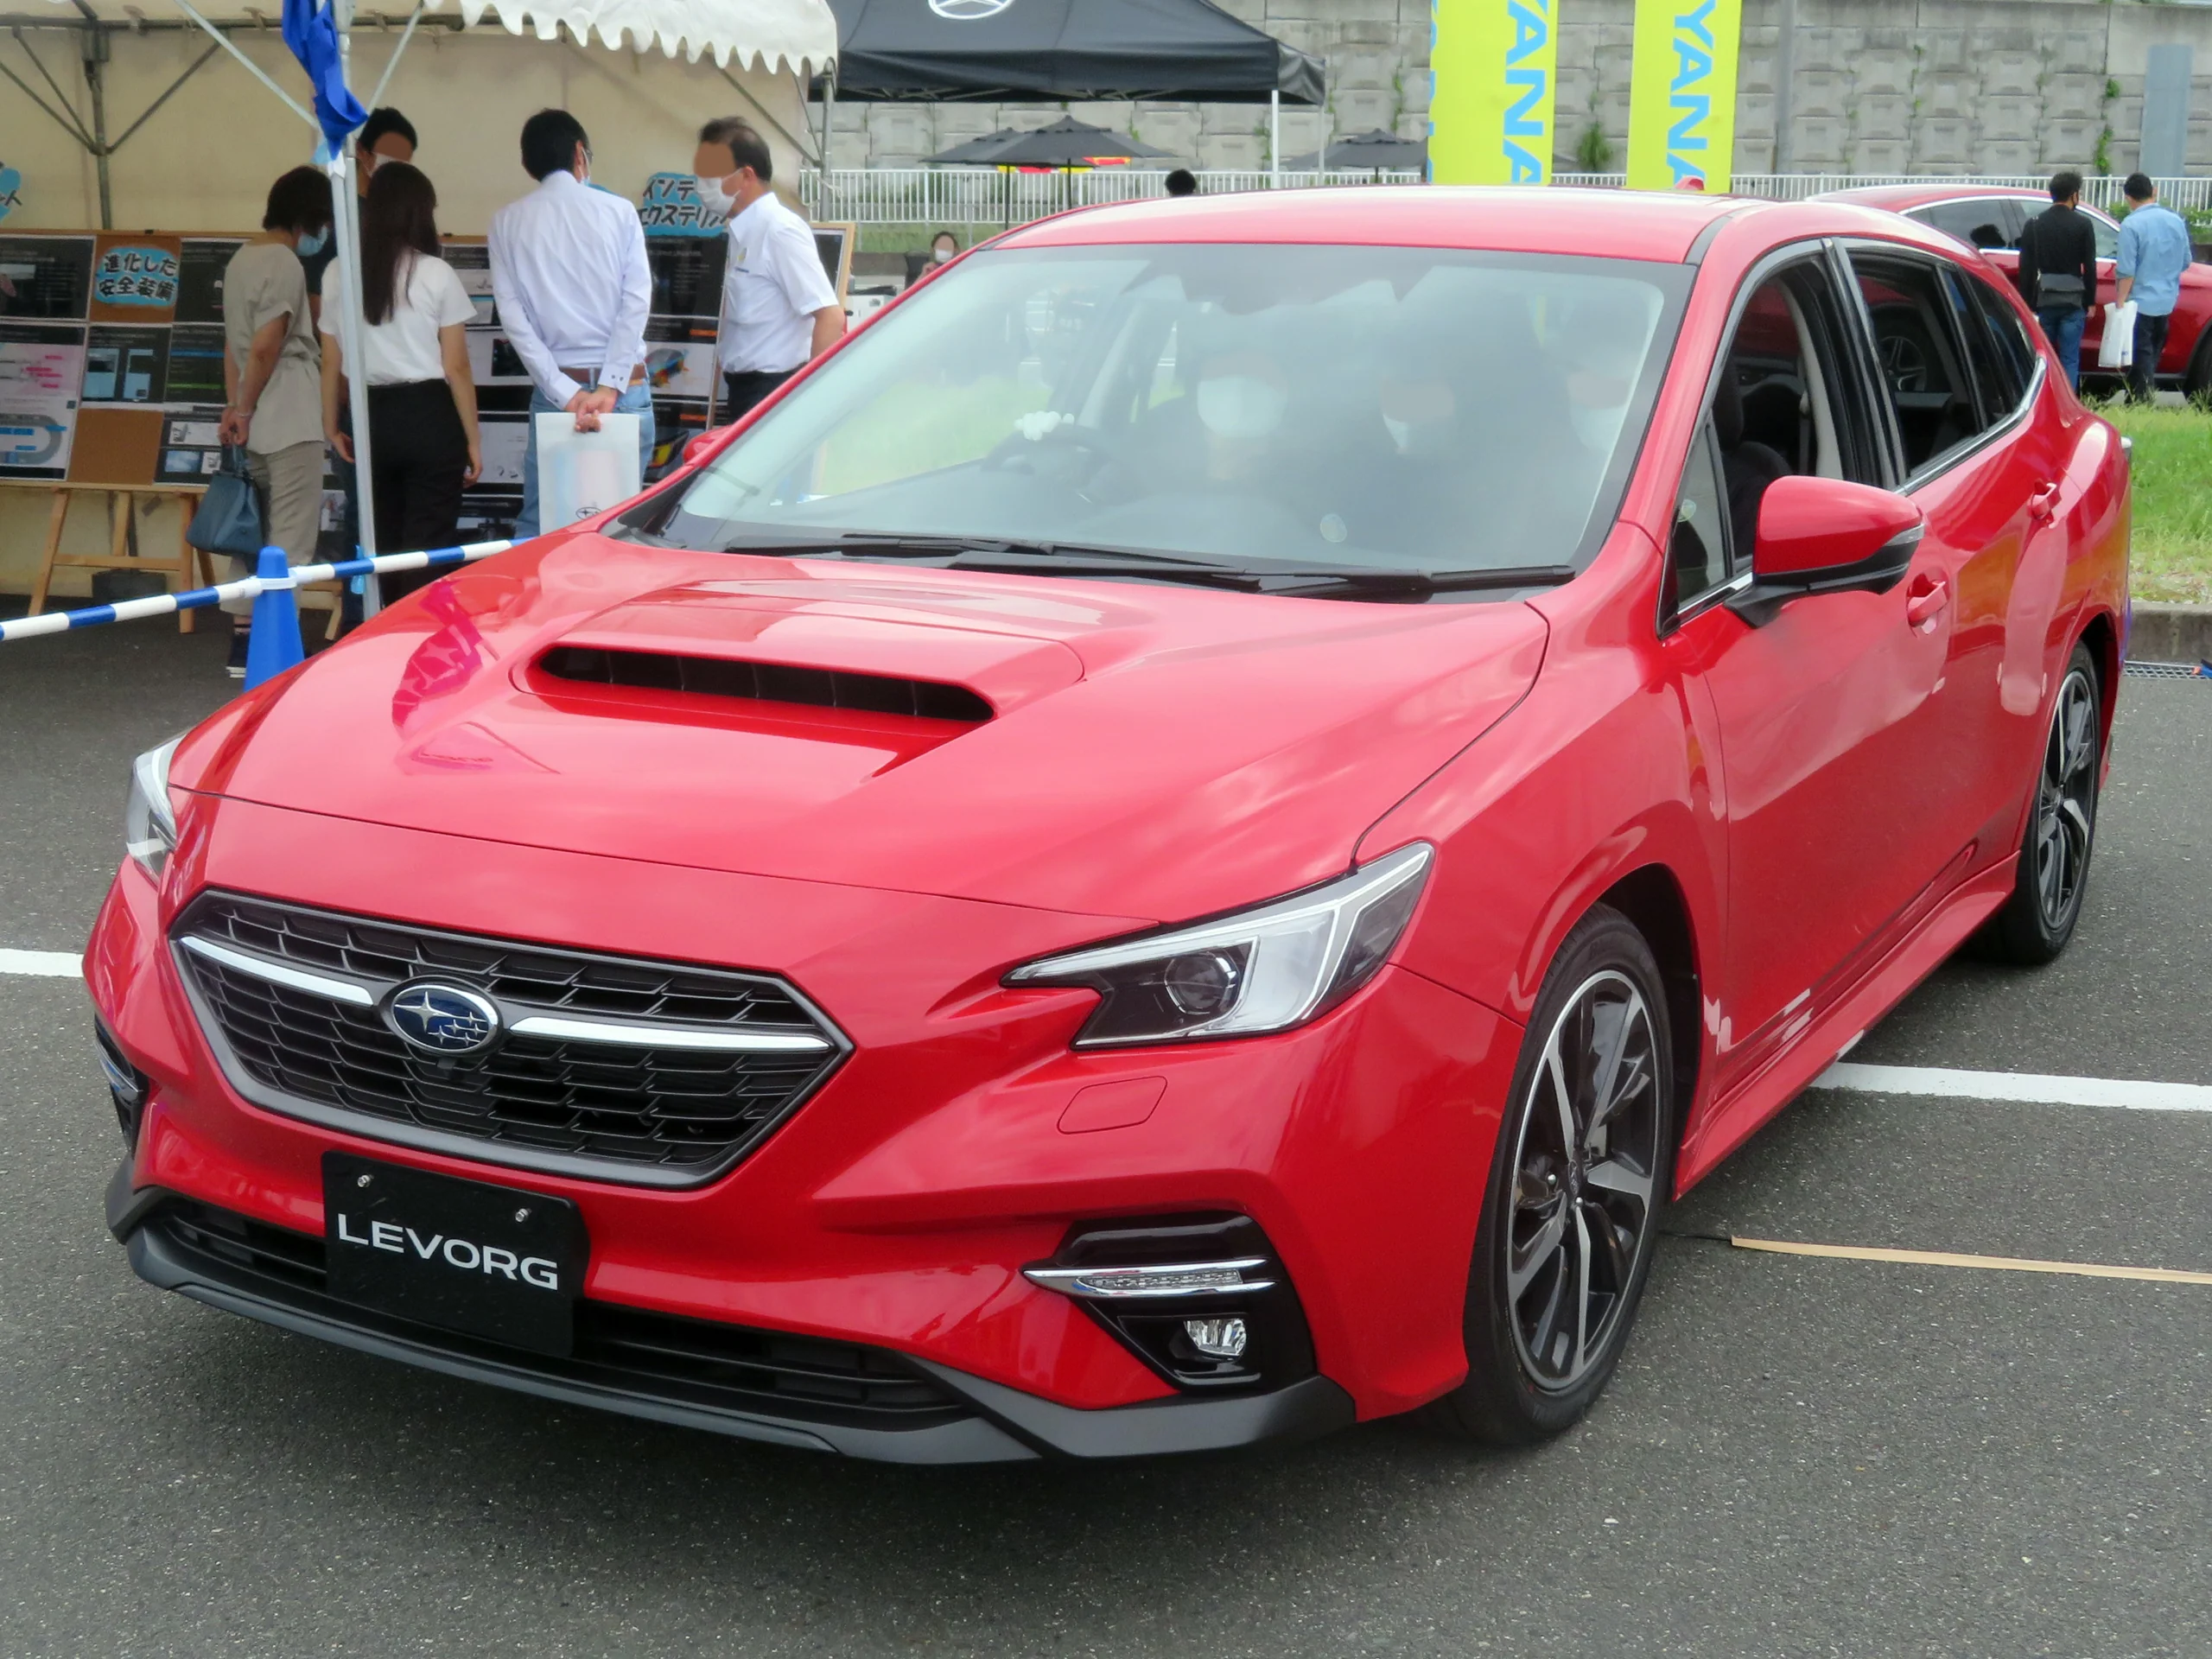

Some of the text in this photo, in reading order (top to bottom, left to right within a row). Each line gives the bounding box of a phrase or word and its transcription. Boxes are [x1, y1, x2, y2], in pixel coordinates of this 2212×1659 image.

[1502, 0, 1548, 184] ANA
[99, 276, 175, 302] 安全装備
[105, 252, 176, 276] 進化した
[338, 1213, 558, 1291] LEVORG
